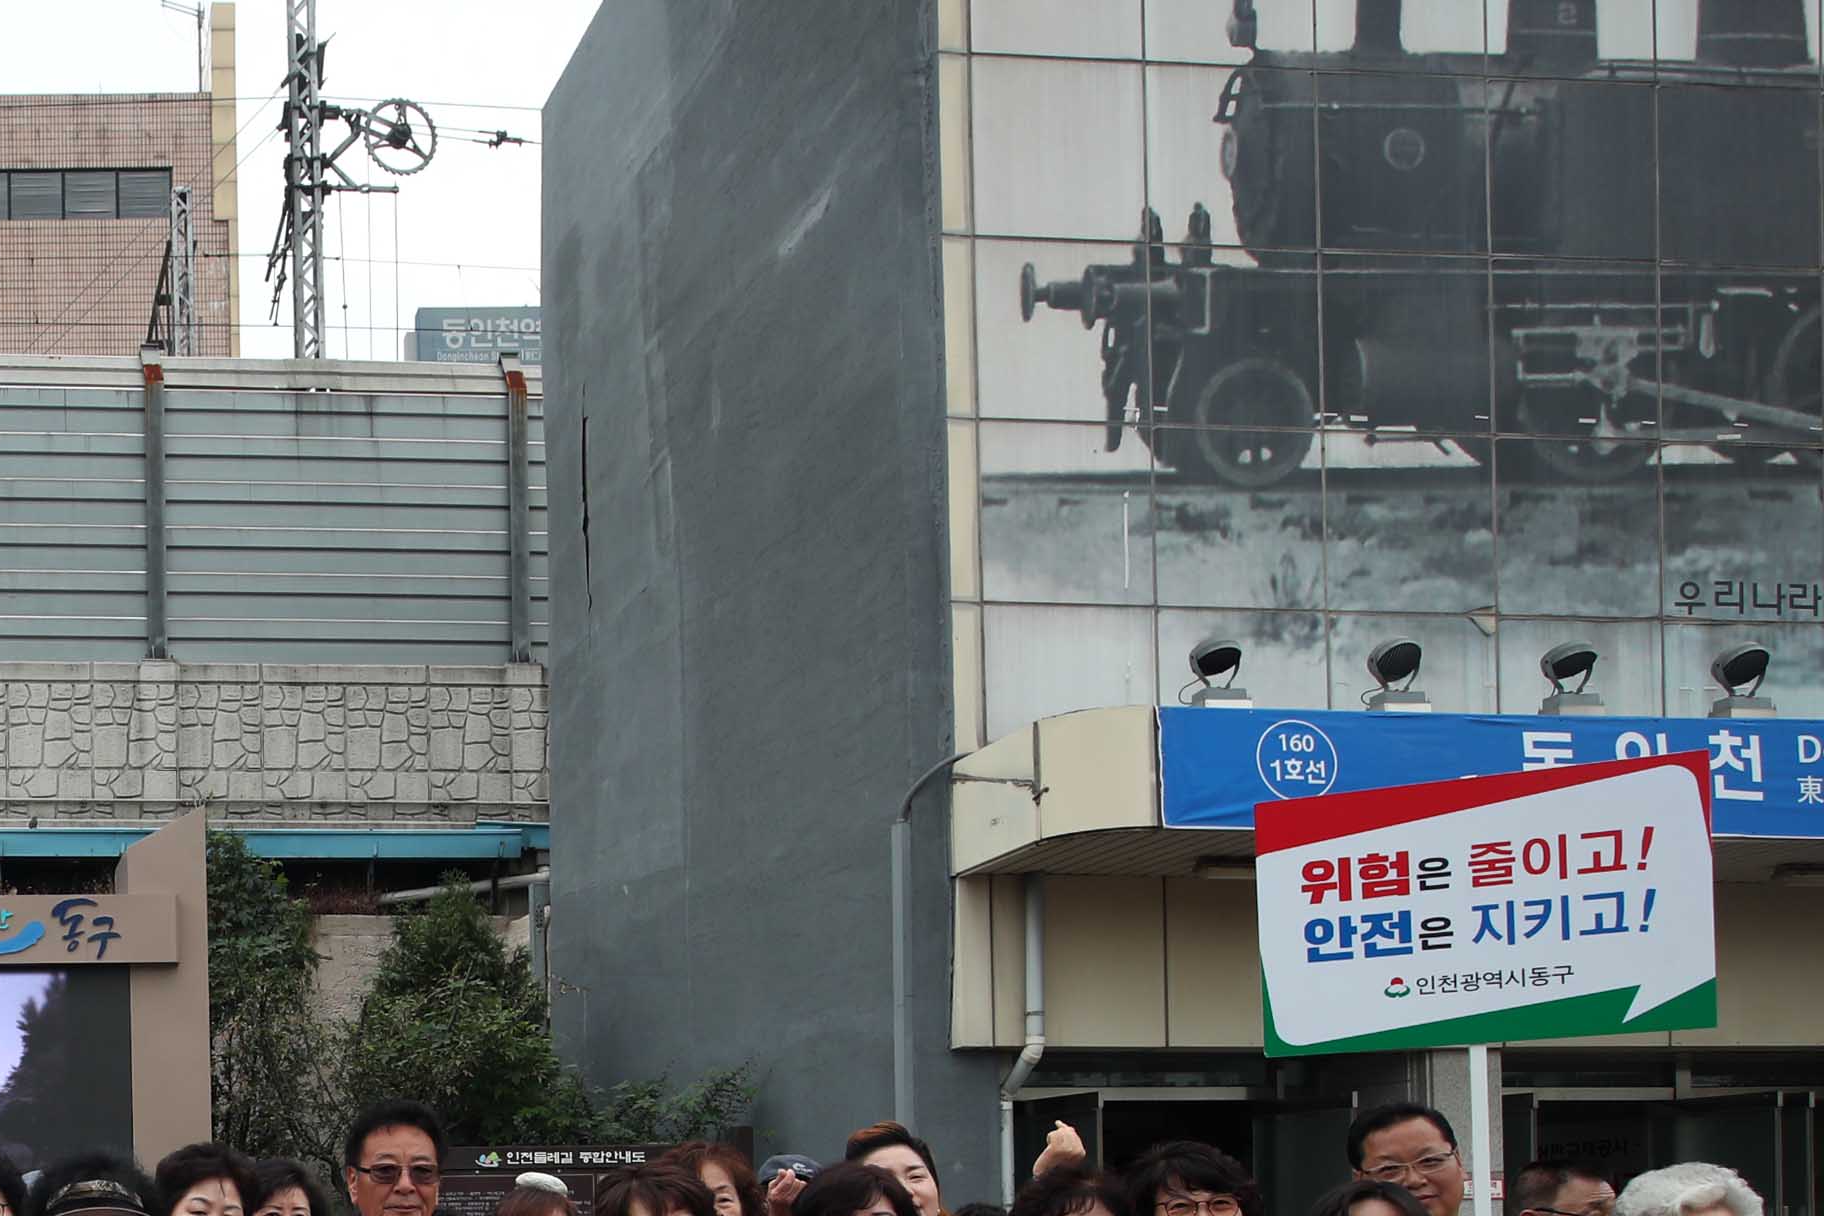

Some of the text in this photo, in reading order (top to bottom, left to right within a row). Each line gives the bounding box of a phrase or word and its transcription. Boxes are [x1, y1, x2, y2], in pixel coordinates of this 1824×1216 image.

[1674, 581, 1824, 616] 우리나라
[1277, 733, 1315, 753] 160
[1270, 757, 1327, 784] 1호선
[1300, 826, 1655, 905] 위험은 줄이고!
[50, 897, 122, 960] 동구
[1303, 888, 1656, 964] 안전은 지키고!
